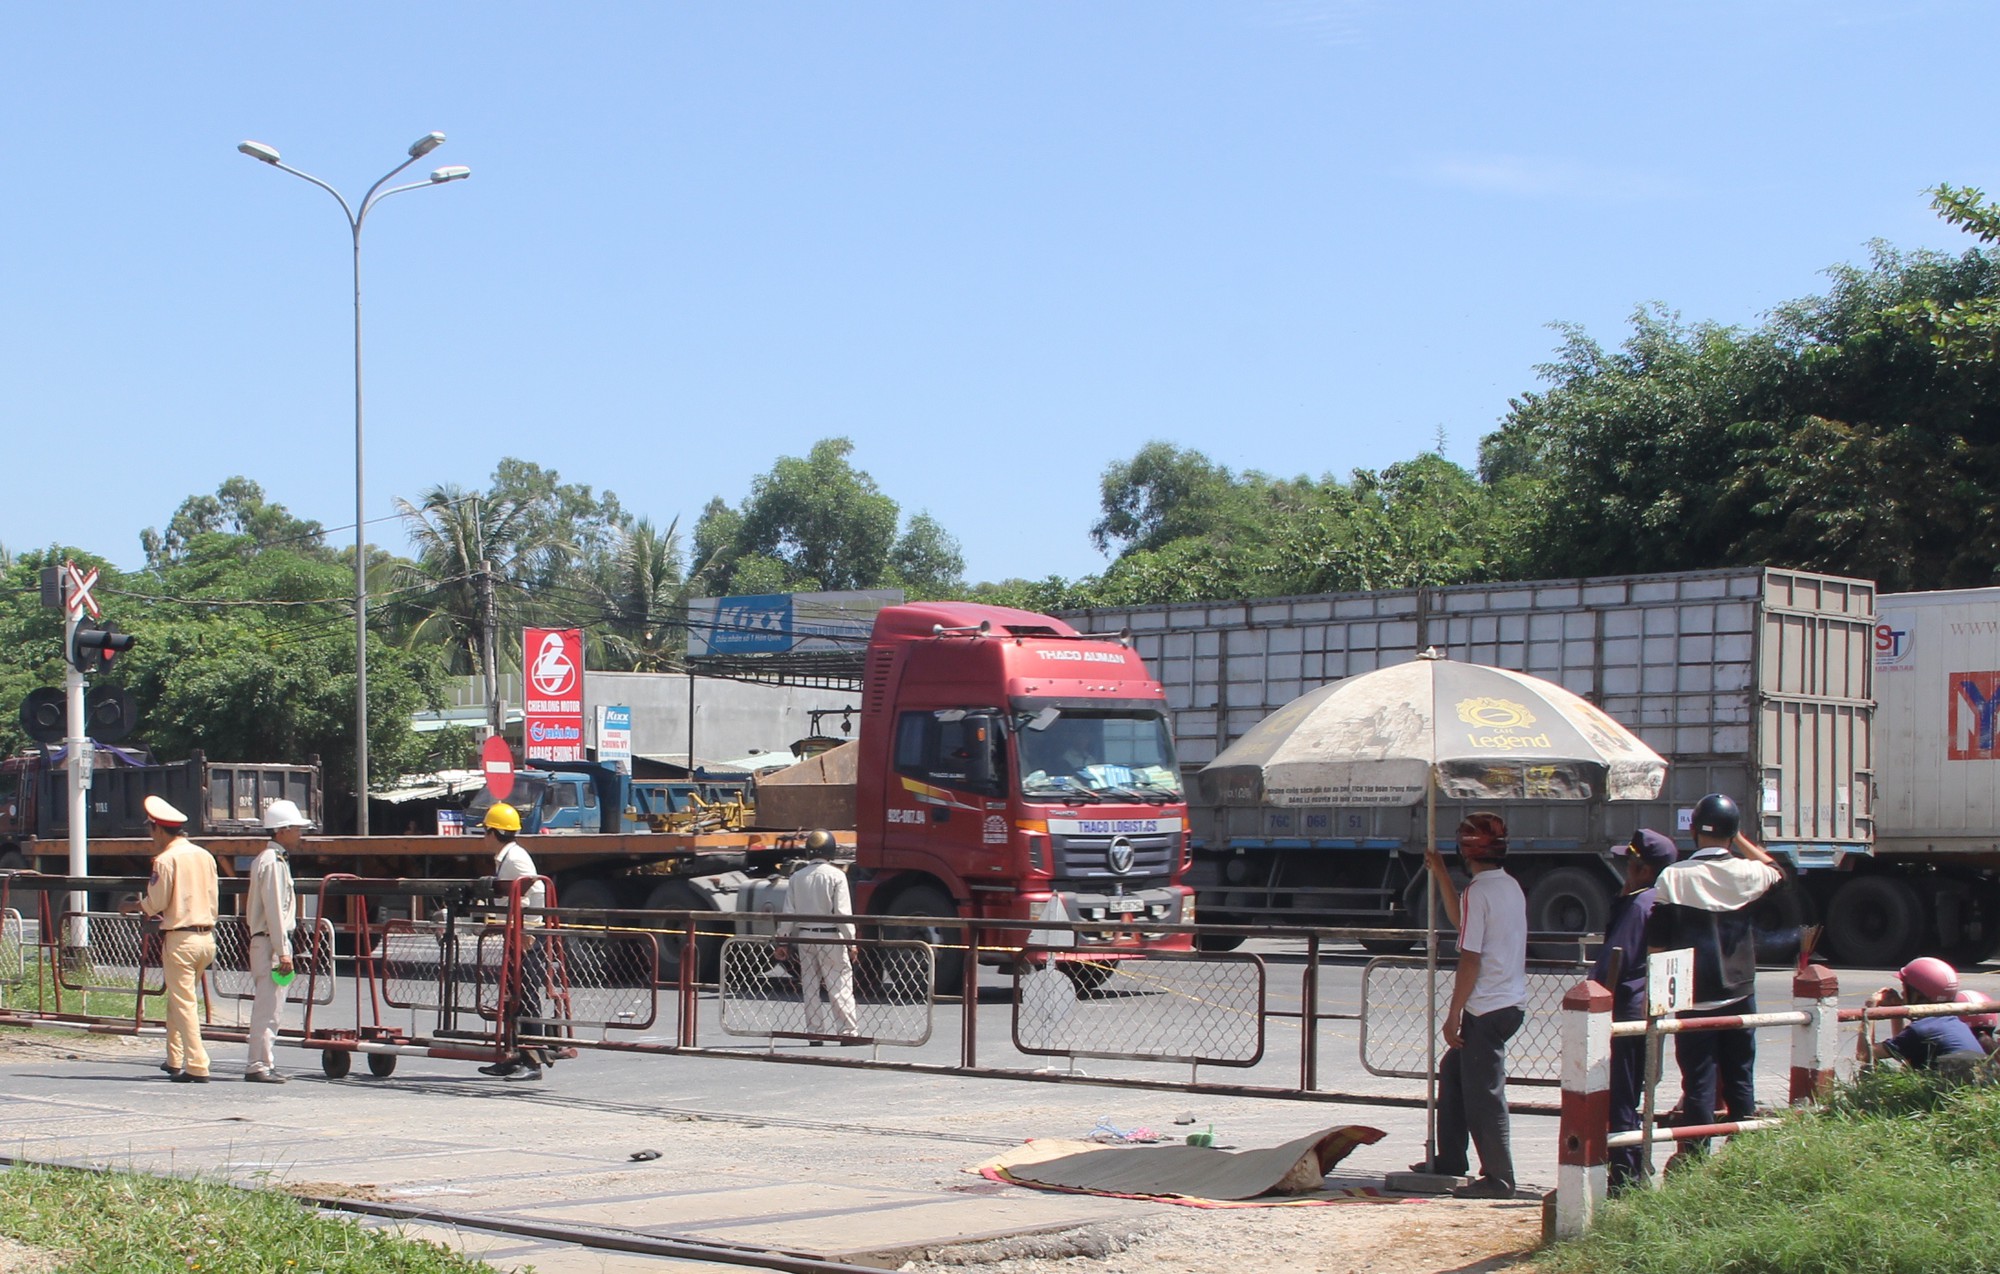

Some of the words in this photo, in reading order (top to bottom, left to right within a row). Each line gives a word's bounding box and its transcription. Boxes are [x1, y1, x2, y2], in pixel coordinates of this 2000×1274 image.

[717, 606, 786, 633] Kixx
[1036, 650, 1082, 660] THACO
[1084, 651, 1125, 664] AUMAN
[528, 700, 560, 712] CHIENLONG
[561, 700, 580, 712] MOTOR
[606, 711, 629, 721] Kixx
[1467, 733, 1552, 750] Legend
[529, 746, 553, 761] GARAGE
[553, 746, 573, 761] CHUNG
[1078, 821, 1109, 833] THACO
[1270, 815, 1290, 828] 76C
[1307, 815, 1327, 828] 068
[1349, 816, 1362, 828] 51
[1668, 976, 1676, 1008] 9
